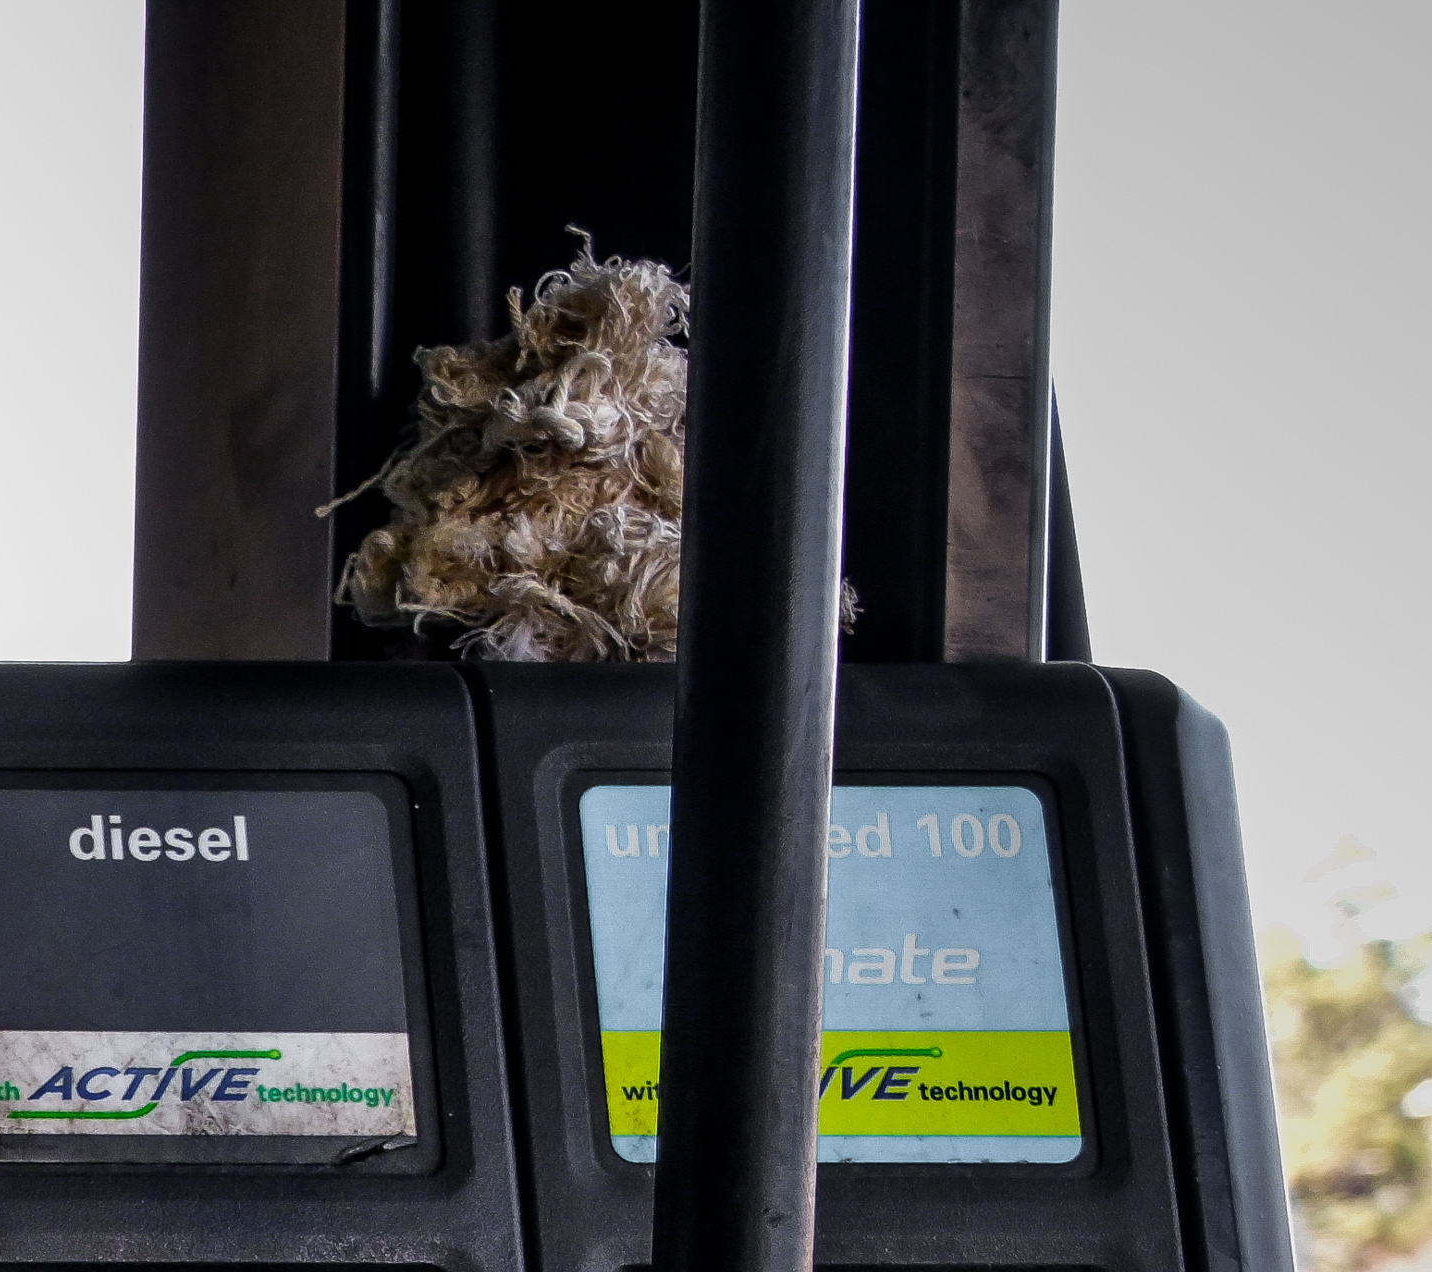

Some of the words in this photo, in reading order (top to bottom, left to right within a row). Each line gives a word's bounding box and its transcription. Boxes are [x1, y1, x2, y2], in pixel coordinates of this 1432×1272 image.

[68, 814, 250, 862] diesel
[917, 812, 1021, 860] 100
[28, 1066, 261, 1101] ACTIVE
[257, 1083, 395, 1107] technology
[918, 1082, 1058, 1107] technology
